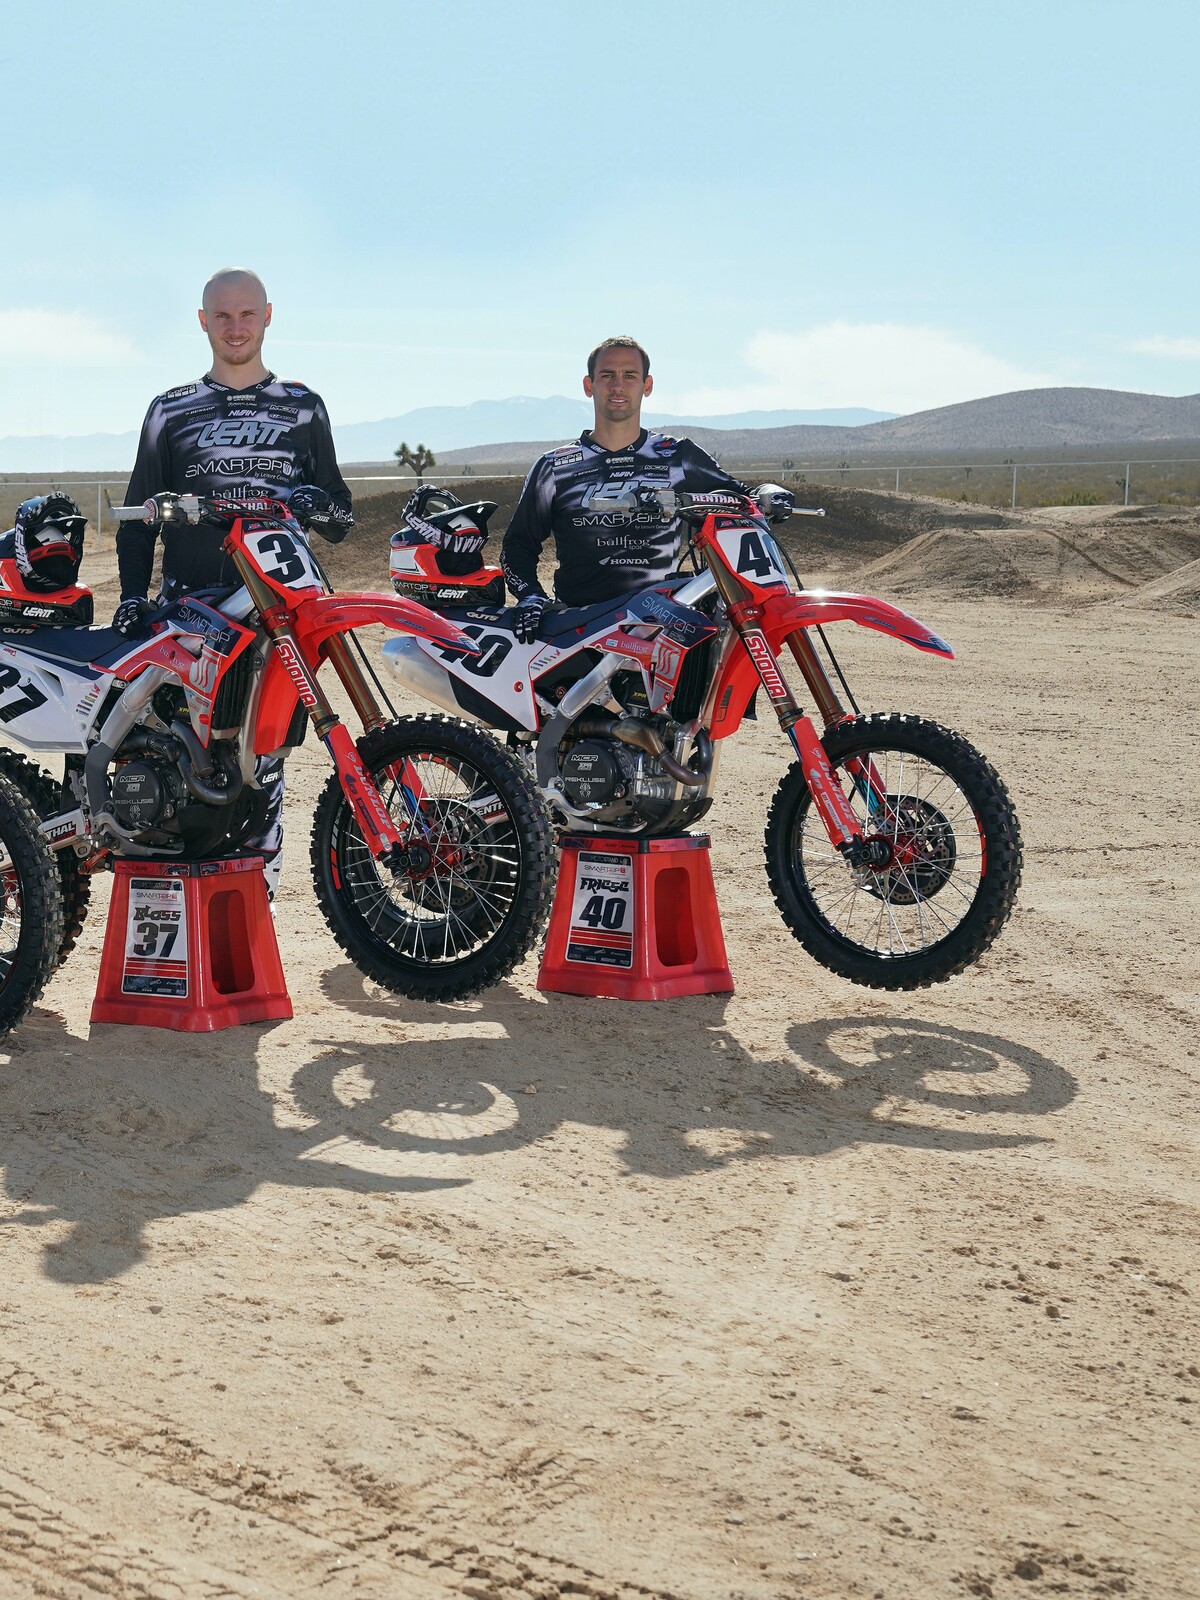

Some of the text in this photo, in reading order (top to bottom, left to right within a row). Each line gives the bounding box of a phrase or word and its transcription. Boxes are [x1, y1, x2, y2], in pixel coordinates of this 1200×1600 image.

[197, 421, 293, 448] LEATT
[692, 494, 742, 504] RENTHAL
[597, 534, 650, 549] bullfrog
[257, 533, 318, 584] 3
[437, 588, 468, 599] LEATT
[23, 606, 55, 618] LEATT
[466, 611, 499, 622] GUTS
[2, 627, 35, 635] GUTS
[276, 643, 318, 707] SHOWA
[744, 636, 787, 699] SHOWA
[571, 754, 599, 762] MCR
[119, 774, 146, 783] MCR
[564, 776, 606, 784] REKLUSE
[354, 764, 392, 830] DUNLOP
[818, 761, 856, 824] DUNLOP
[114, 797, 154, 805] REKLUSE
[47, 821, 76, 838] THAL
[579, 895, 627, 930] 40
[133, 922, 179, 958] 37
